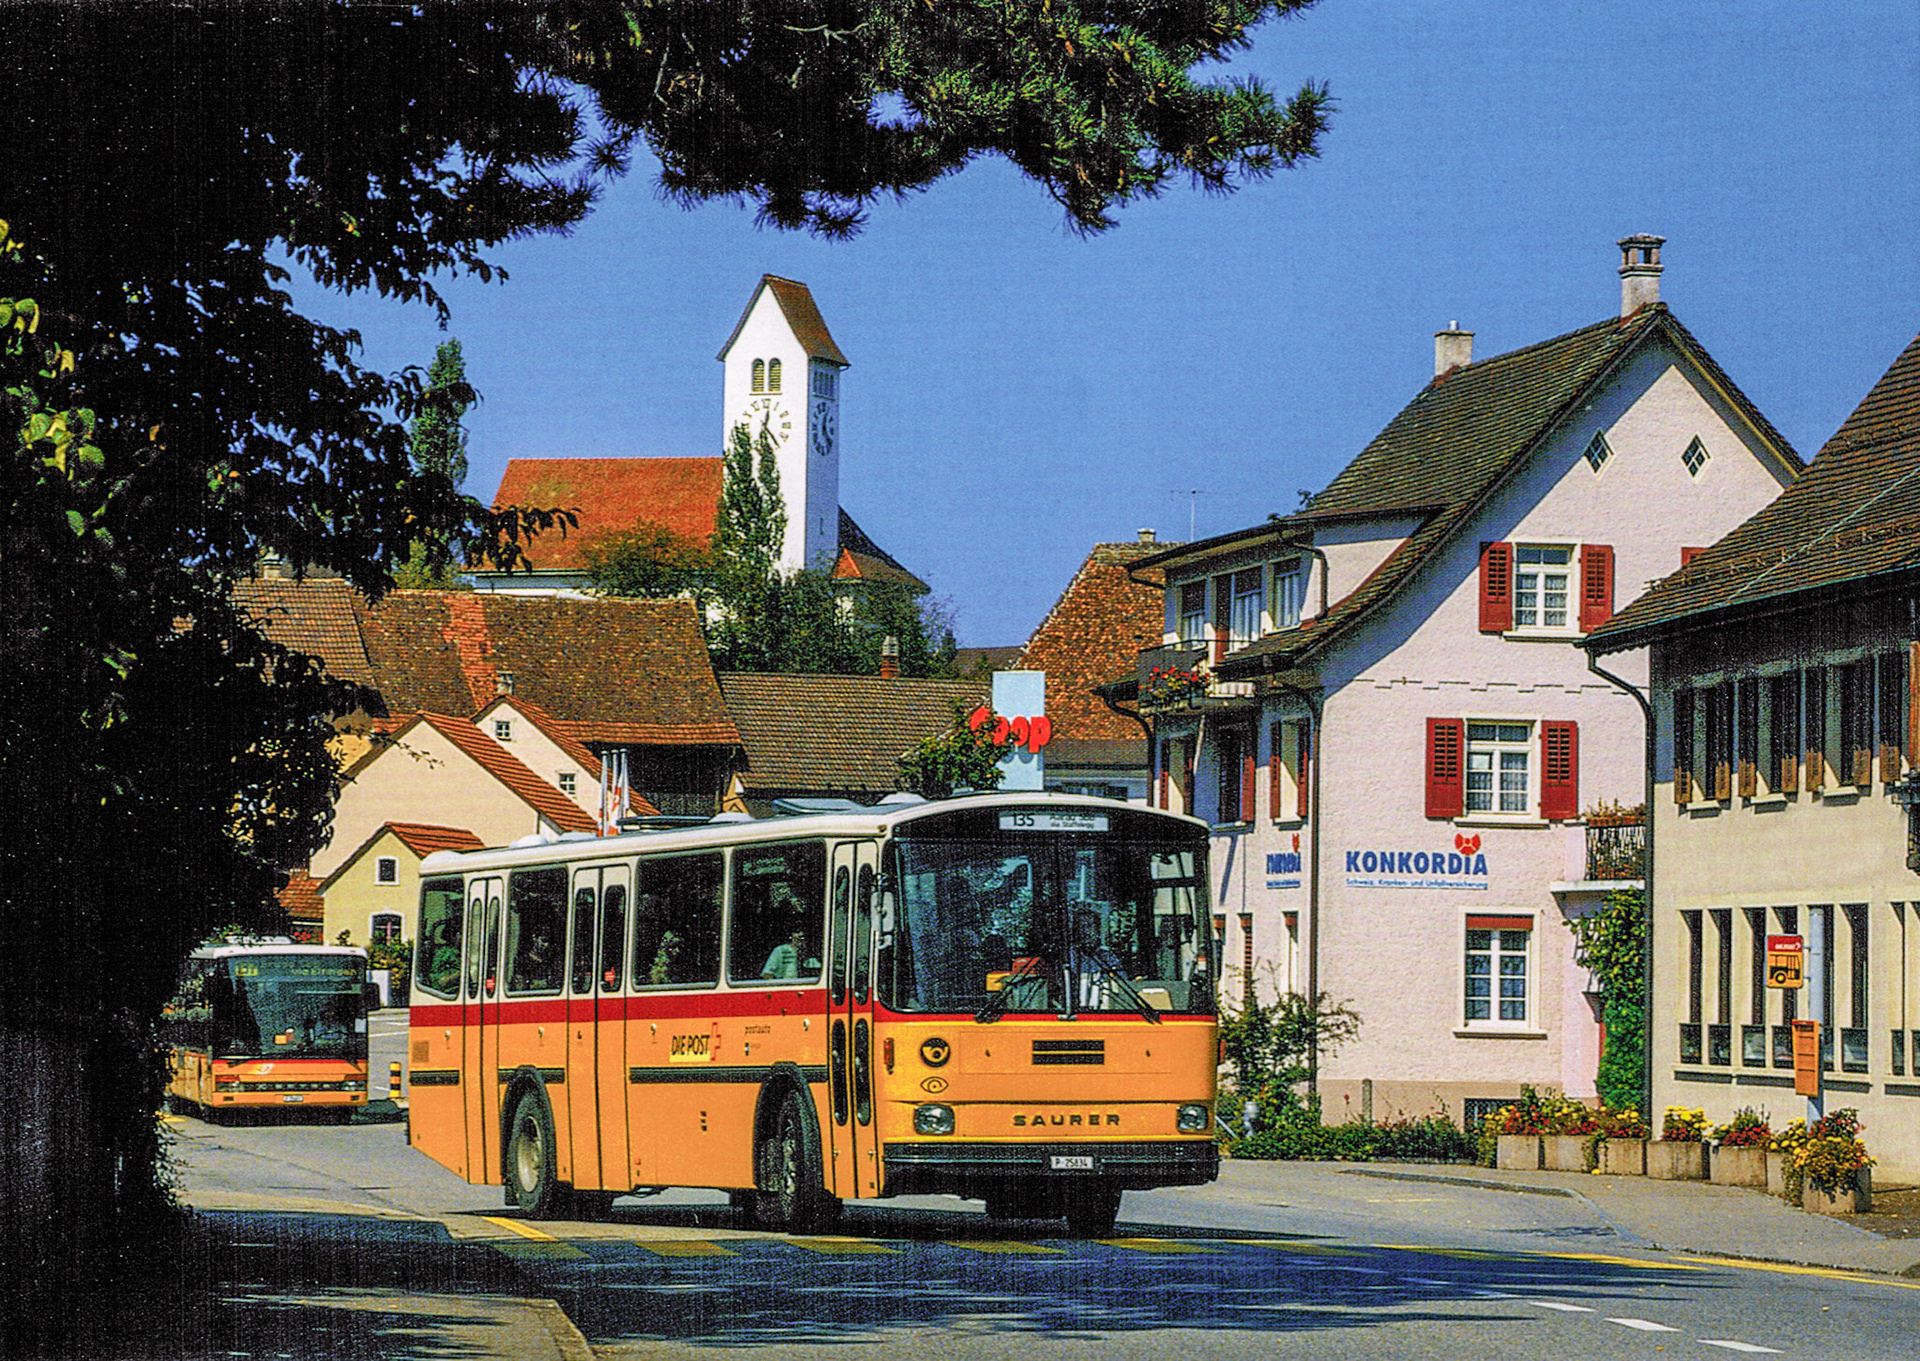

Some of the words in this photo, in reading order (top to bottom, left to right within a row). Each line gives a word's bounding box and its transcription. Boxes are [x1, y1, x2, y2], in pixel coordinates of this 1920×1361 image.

[1013, 813, 1035, 827] 135
[1346, 851, 1488, 875] KONKORDIA
[671, 1035, 686, 1056] DIE
[687, 1034, 710, 1055] POST
[1012, 1114, 1120, 1127] SAURER
